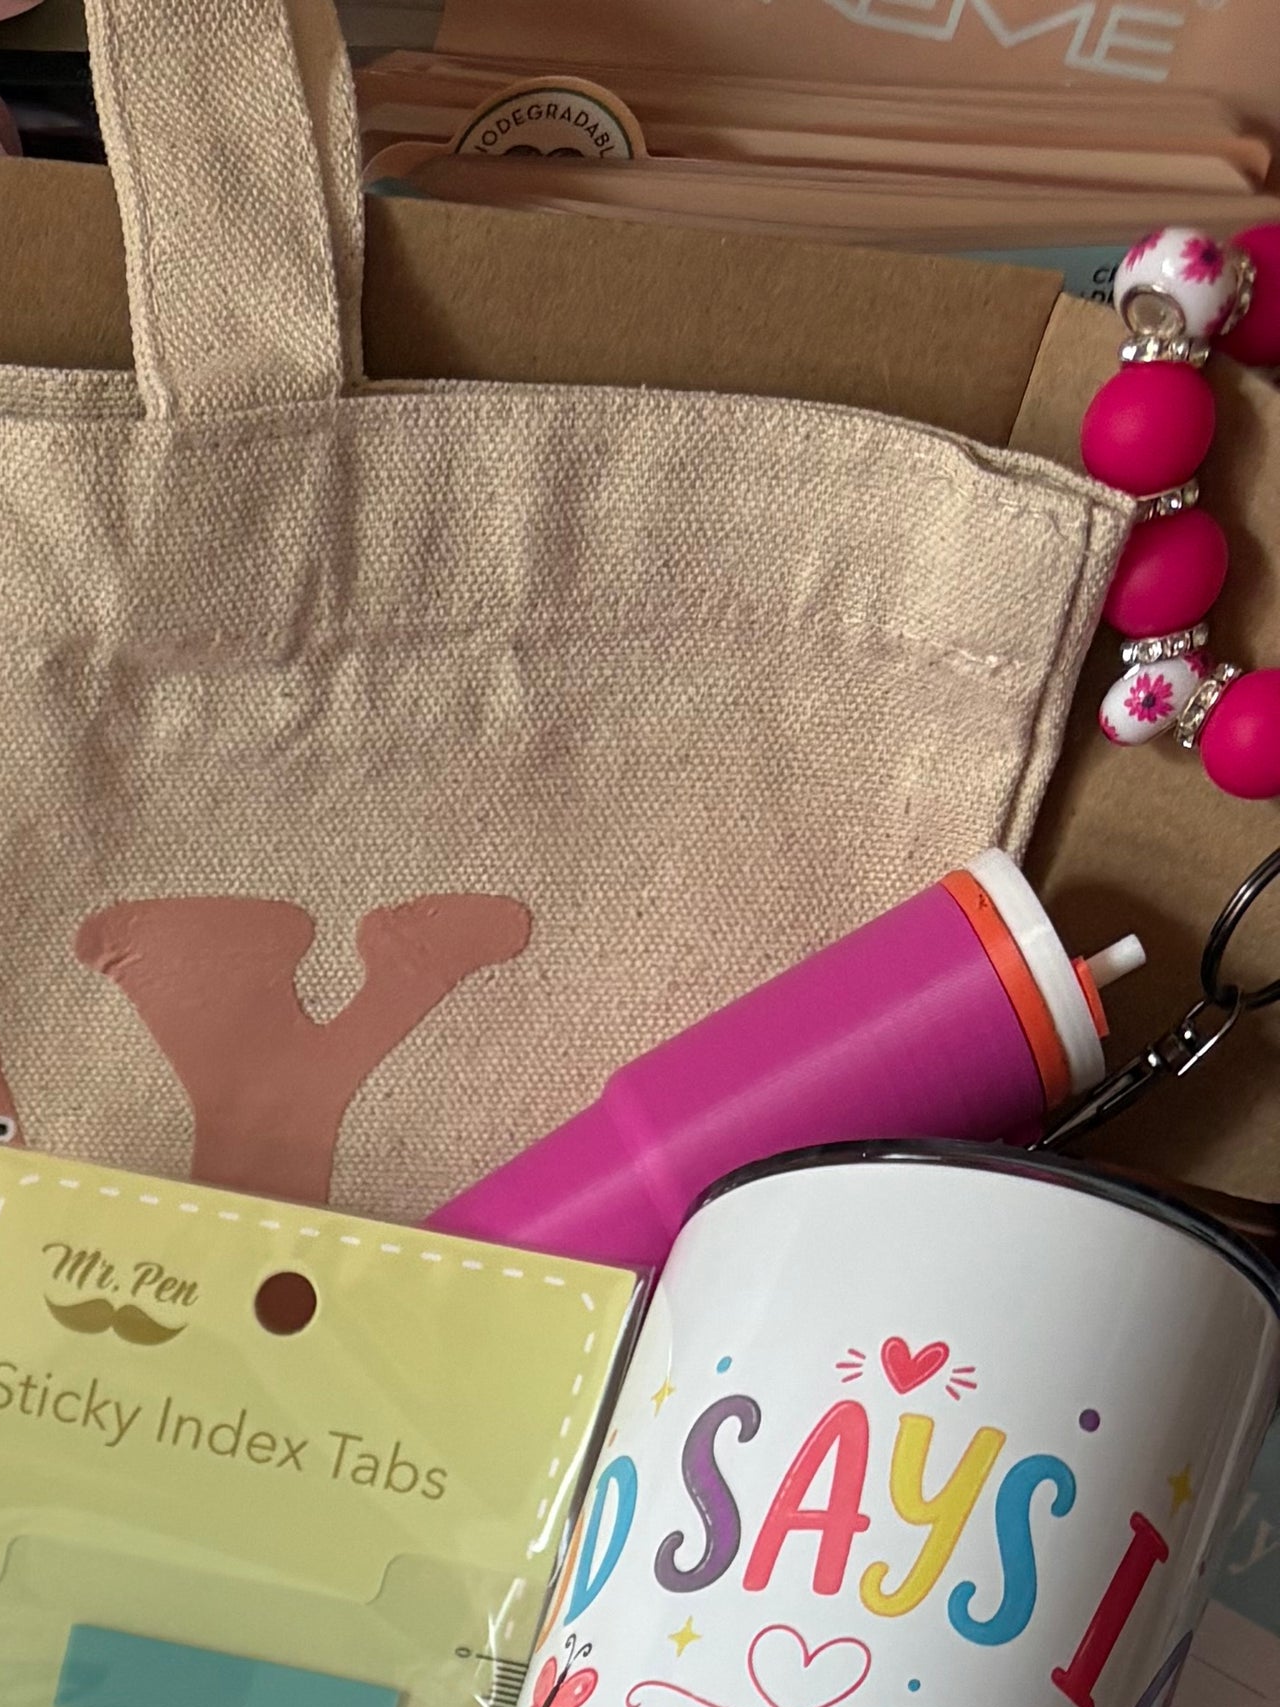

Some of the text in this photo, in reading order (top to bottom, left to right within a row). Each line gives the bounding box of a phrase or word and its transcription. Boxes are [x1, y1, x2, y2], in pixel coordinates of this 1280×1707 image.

[474, 103, 615, 159] IODEGRADABL
[42, 1242, 198, 1307] Mr. Pen
[156, 1395, 312, 1471] Index
[328, 1430, 449, 1500] Tabs
[653, 1393, 1077, 1648] SAYS
